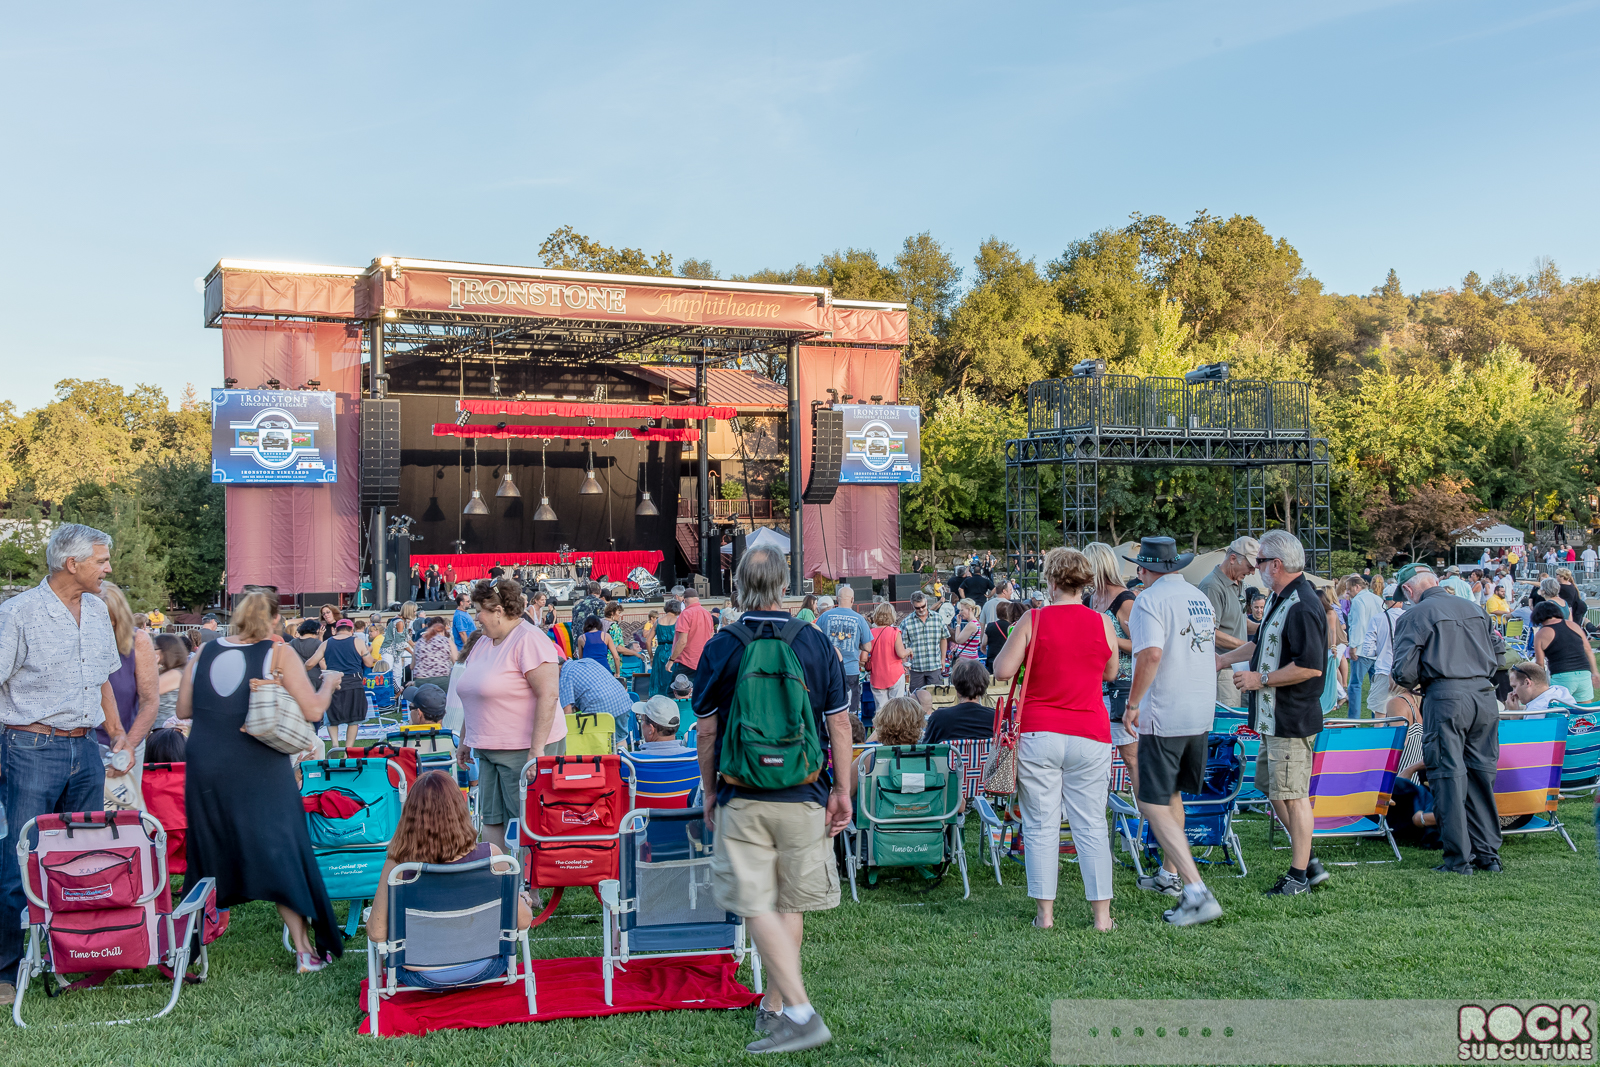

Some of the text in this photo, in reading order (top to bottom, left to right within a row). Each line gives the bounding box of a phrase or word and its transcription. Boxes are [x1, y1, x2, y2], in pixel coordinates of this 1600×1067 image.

[448, 277, 781, 321] IRONSTONE Amphitheatre
[241, 395, 308, 404] IRONSTONE
[853, 408, 900, 416] IRONSTONE
[891, 844, 906, 853] Time
[914, 843, 929, 853] Chill
[69, 946, 123, 959] Time to Chill
